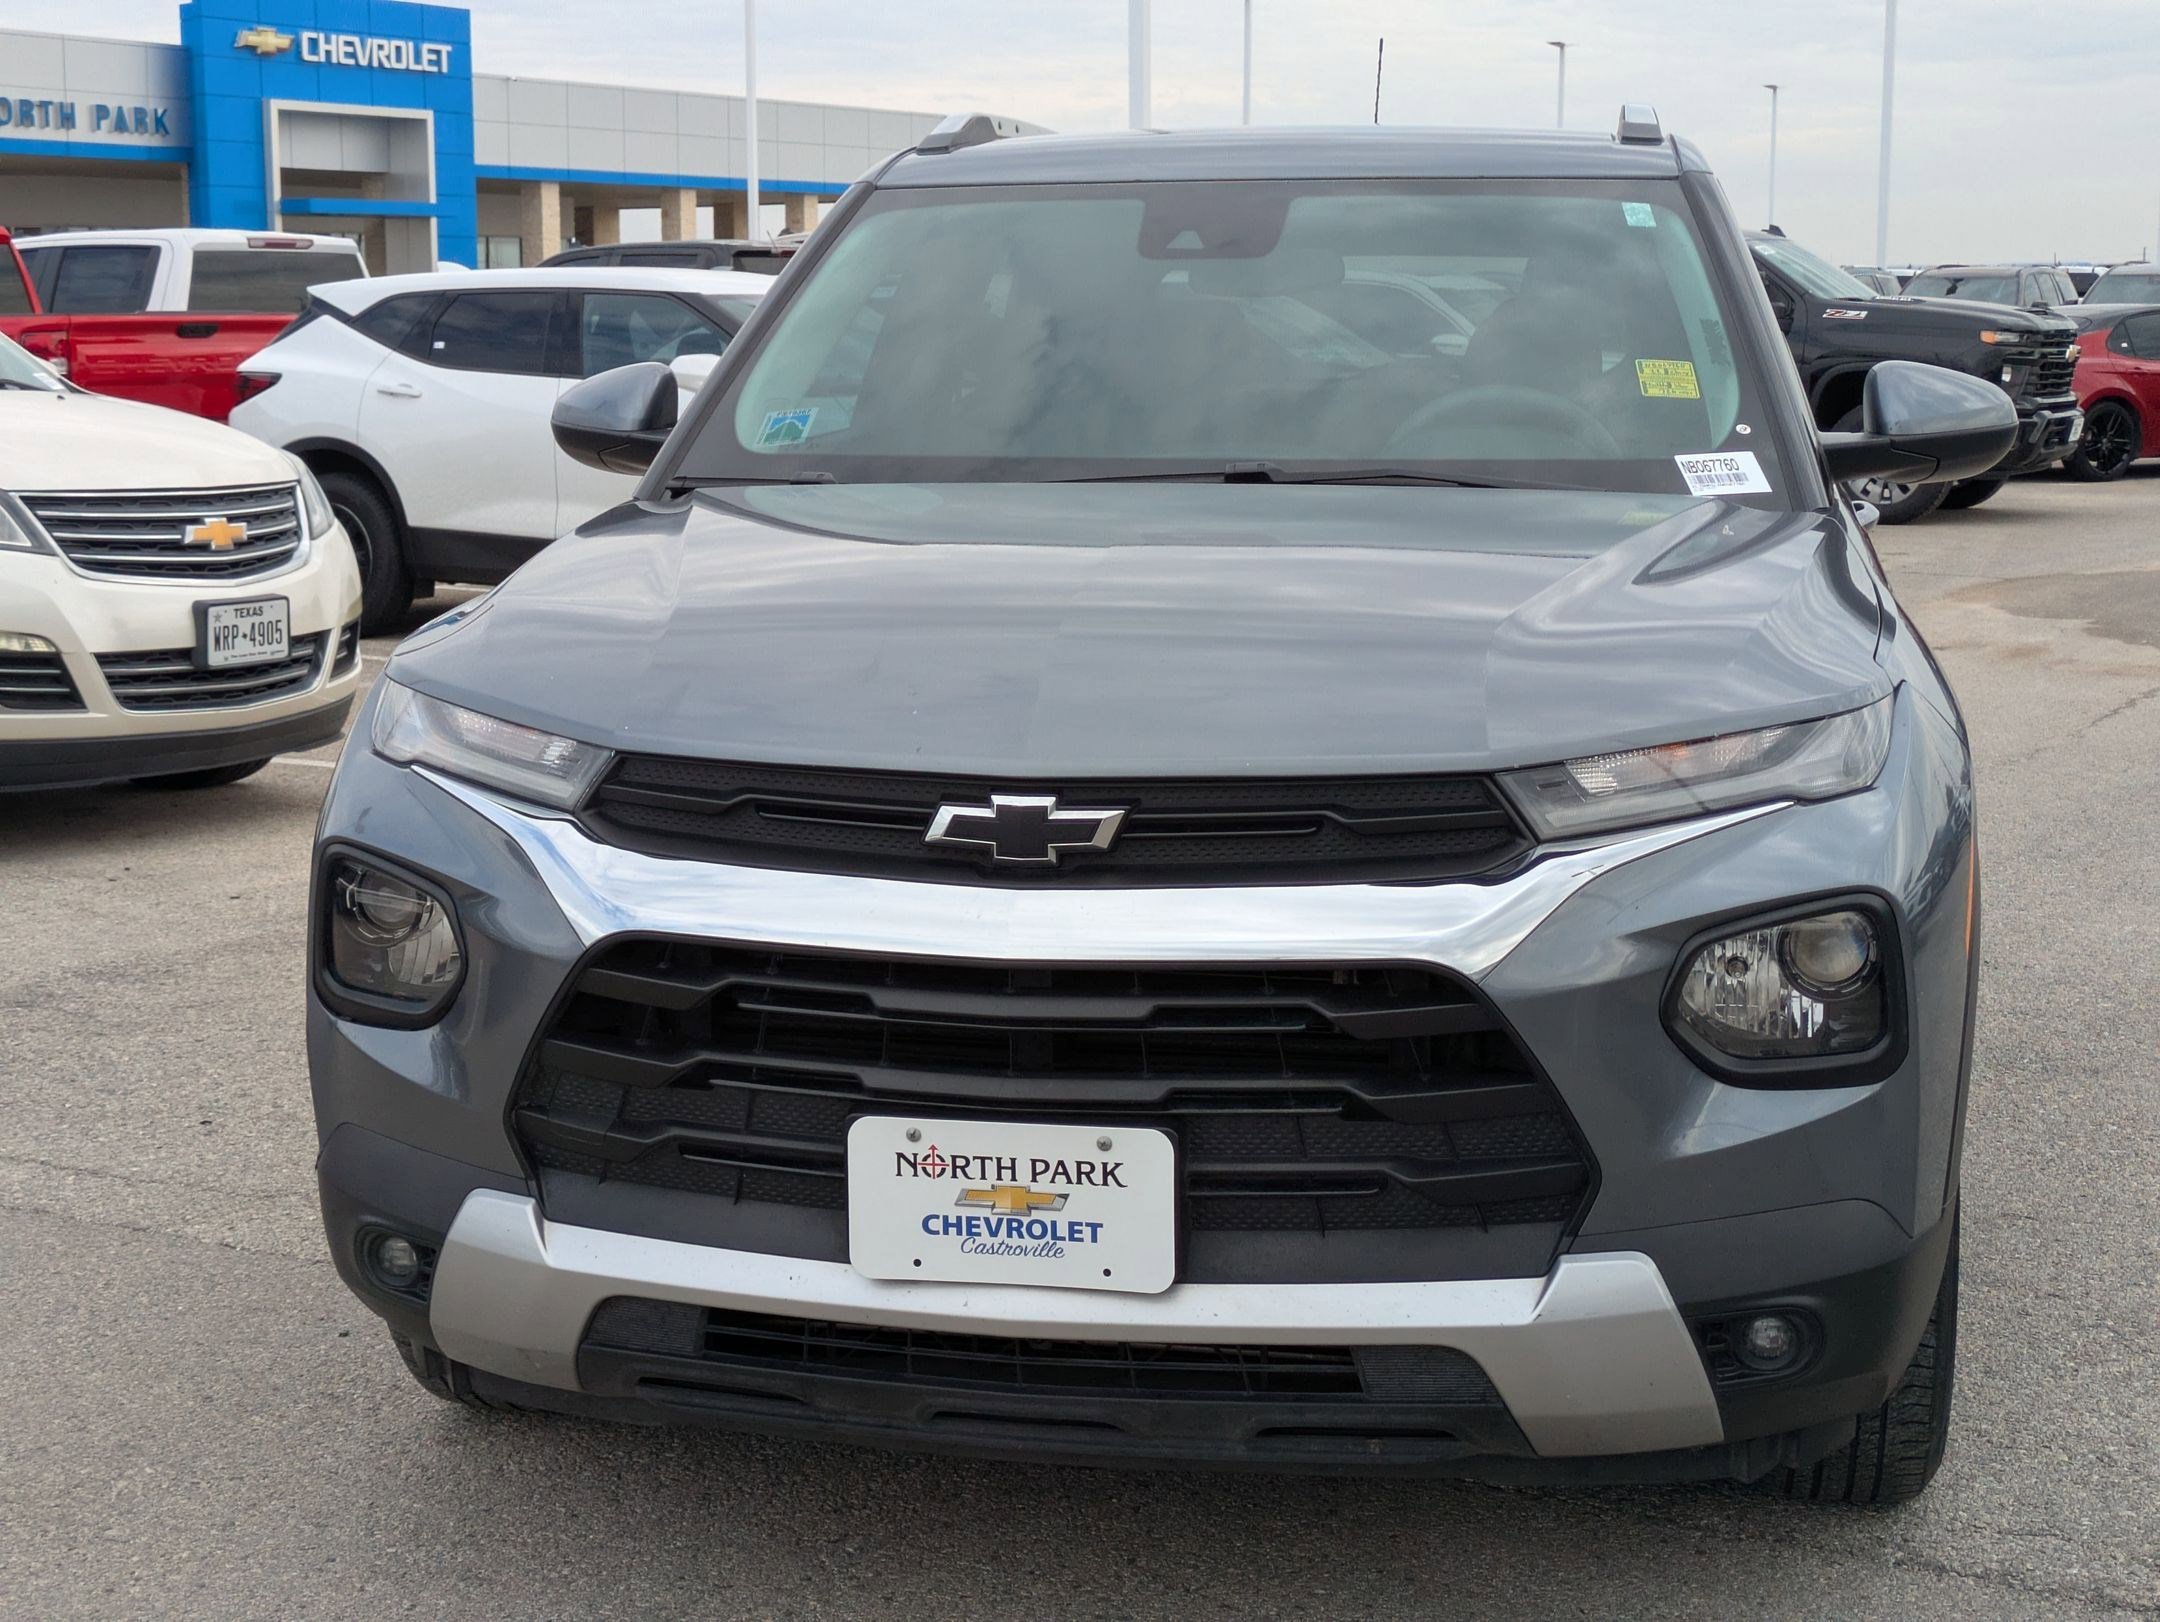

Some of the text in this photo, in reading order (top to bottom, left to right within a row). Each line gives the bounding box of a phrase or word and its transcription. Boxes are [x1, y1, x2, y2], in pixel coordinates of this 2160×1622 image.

[302, 31, 453, 74] CHEVROLET
[0, 97, 170, 136] ORTH PARK
[1680, 458, 1740, 474] NB067760
[233, 606, 264, 619] TEXAS
[895, 1144, 1128, 1188] NORTH PARK
[921, 1213, 1104, 1244] CHEVROLET
[960, 1236, 1066, 1260] Castroville
